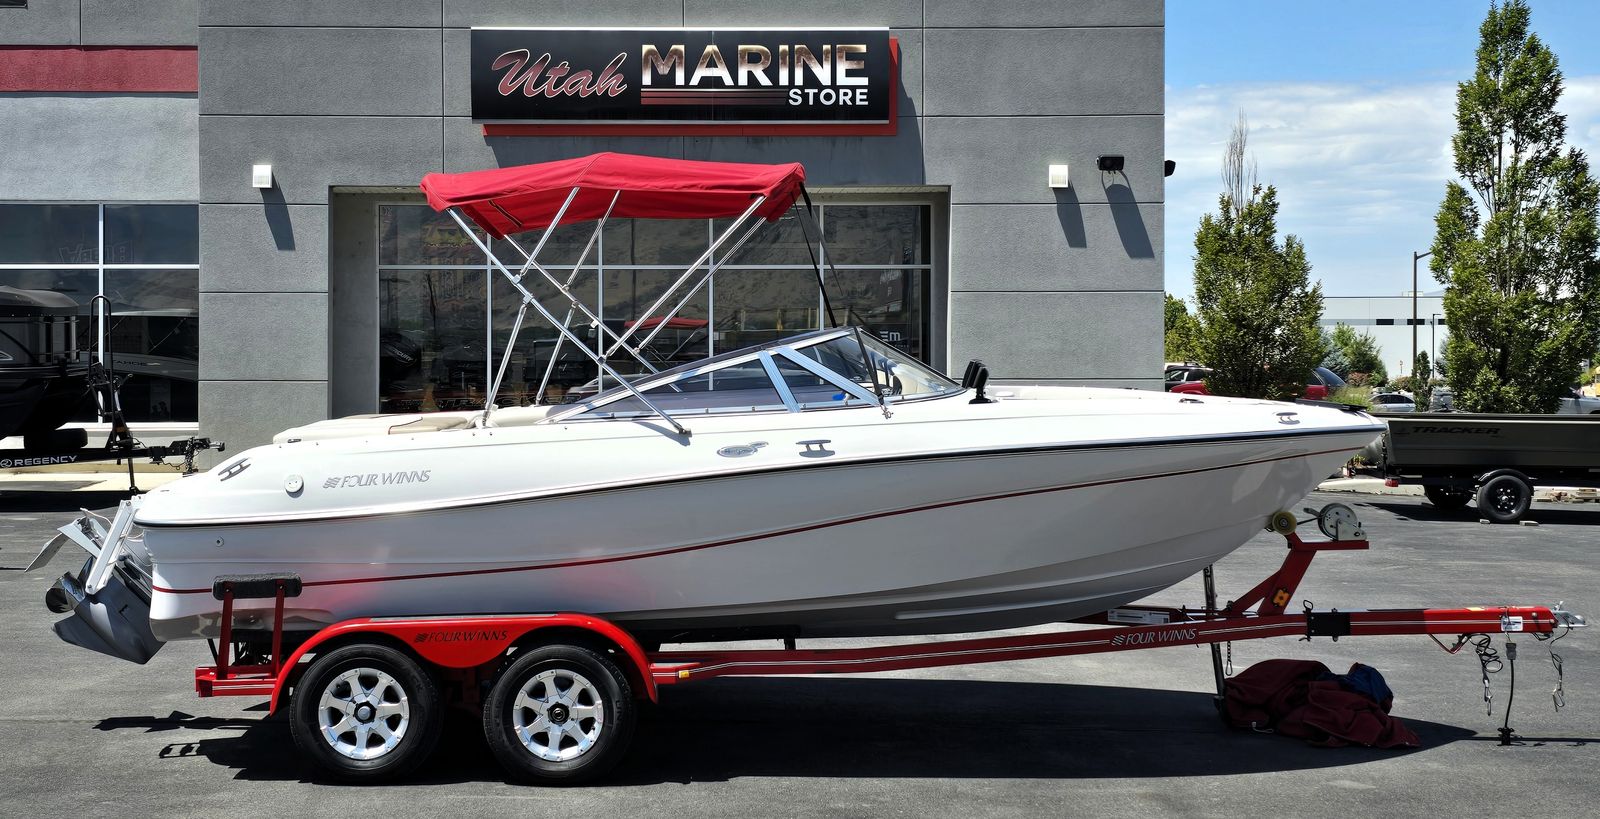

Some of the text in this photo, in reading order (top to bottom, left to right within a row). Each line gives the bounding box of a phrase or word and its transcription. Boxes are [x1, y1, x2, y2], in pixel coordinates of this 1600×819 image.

[491, 44, 869, 98] Utah MARINE
[788, 88, 869, 106] STORE
[1411, 426, 1501, 435] TRACKER
[14, 455, 78, 467] REGENCY
[340, 470, 431, 488] FOUR WINNS
[1126, 628, 1197, 645] FOUR WINNS
